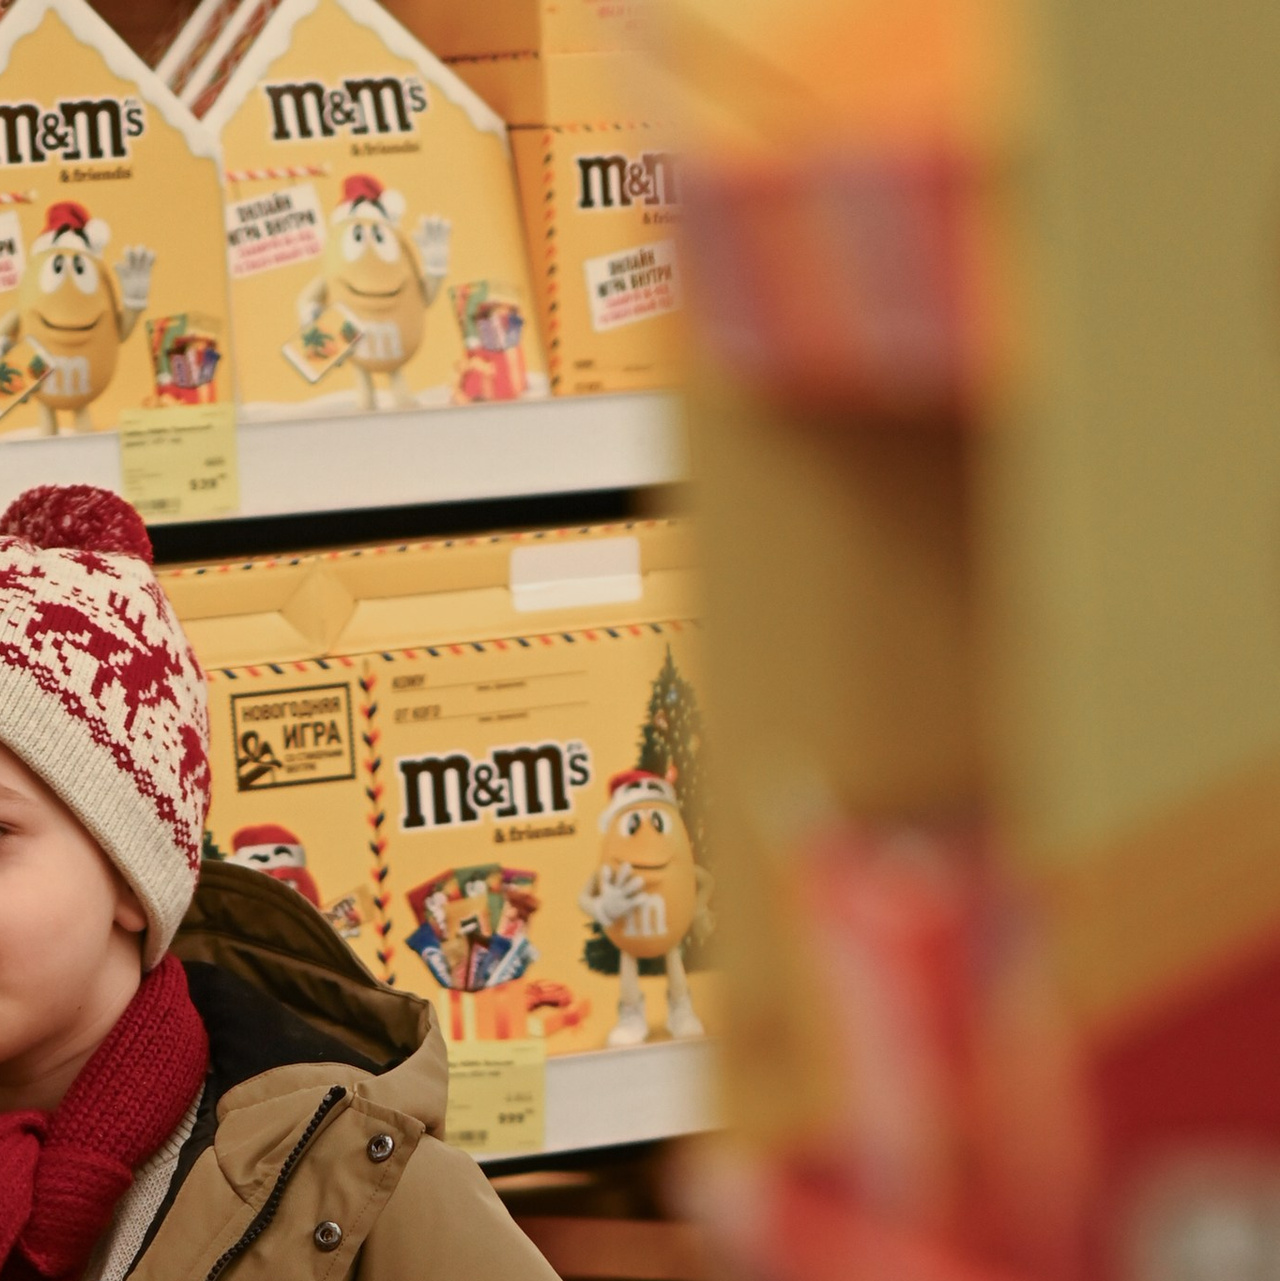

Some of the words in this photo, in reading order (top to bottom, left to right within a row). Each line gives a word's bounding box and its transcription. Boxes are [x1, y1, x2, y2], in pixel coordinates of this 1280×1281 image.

[242, 697, 341, 722] НОВОГОДНЯЯ
[283, 720, 342, 750] ИГРА
[509, 820, 576, 842] friends
